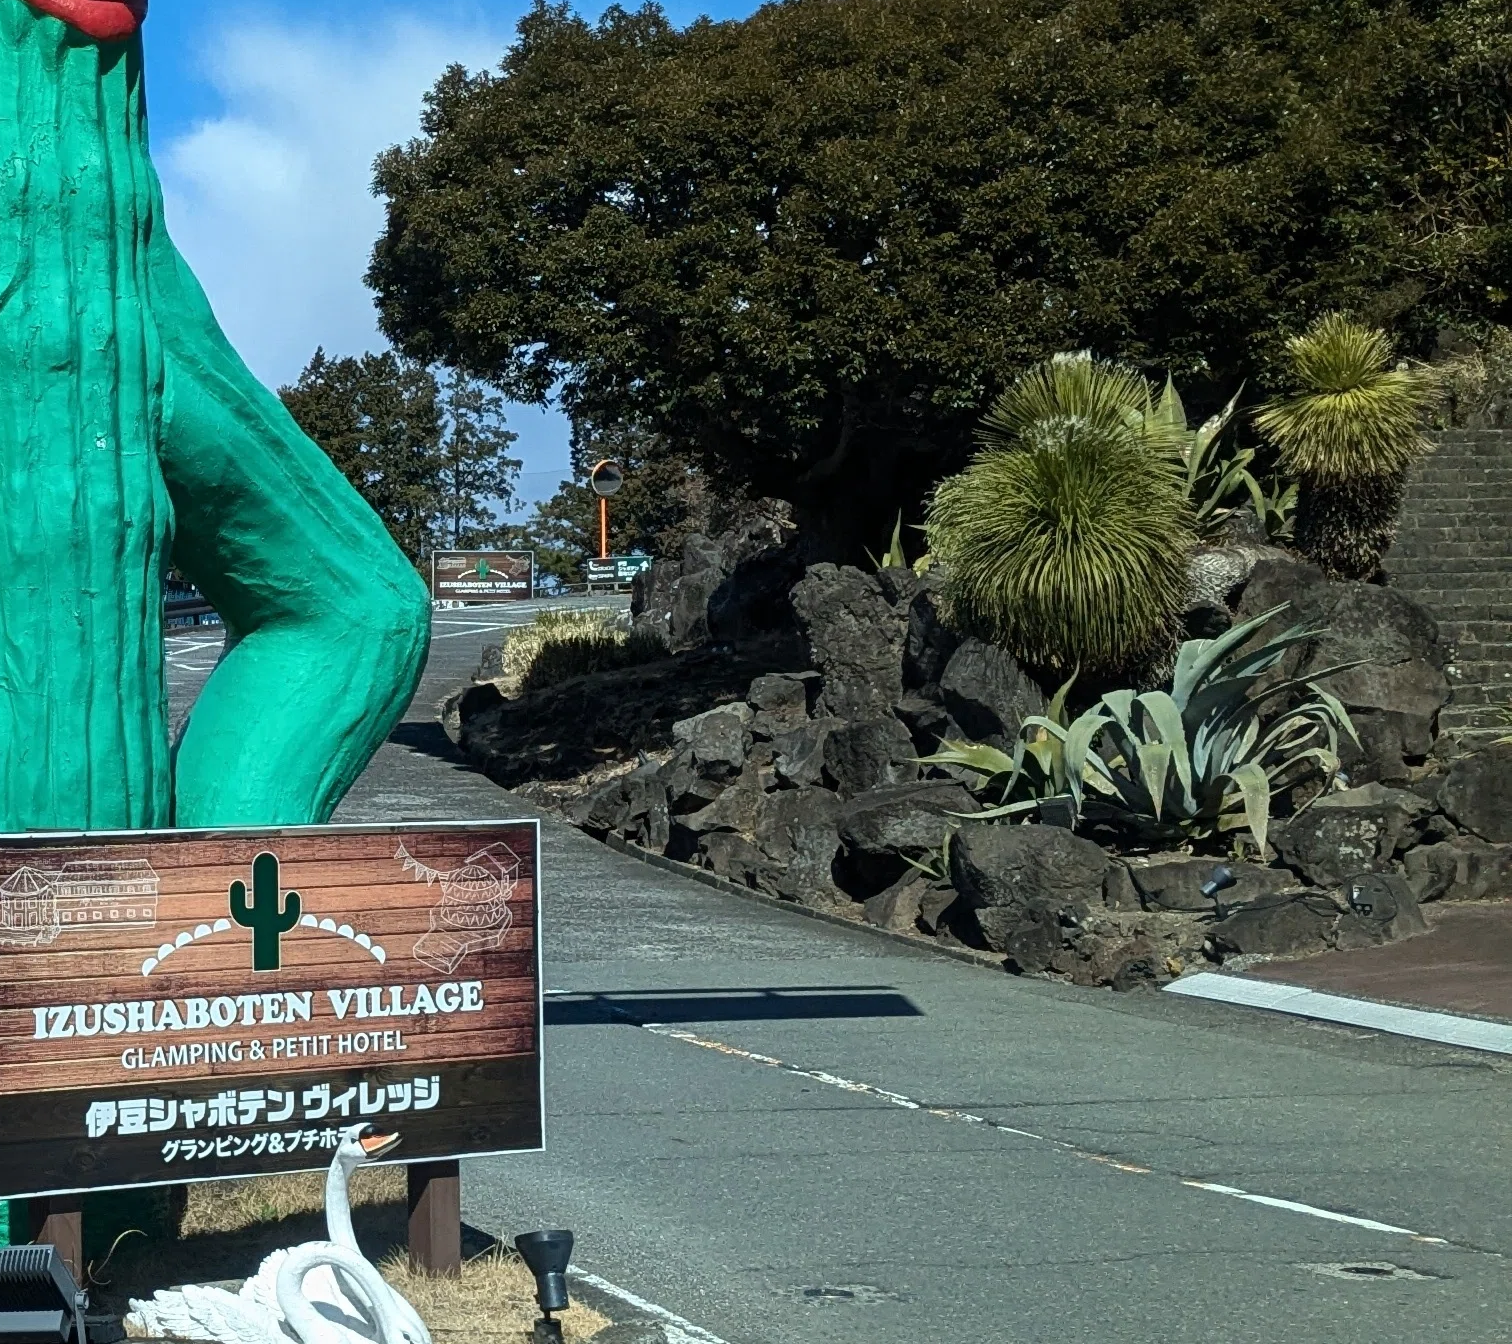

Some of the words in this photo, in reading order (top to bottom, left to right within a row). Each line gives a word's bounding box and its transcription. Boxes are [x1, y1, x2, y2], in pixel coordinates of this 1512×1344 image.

[32, 992, 314, 1040] IZUSHABOTEN
[327, 980, 485, 1020] VILLAGE
[121, 1040, 243, 1070] GLAMPING
[249, 1039, 266, 1060] &
[273, 1034, 332, 1059] PETIT
[338, 1030, 408, 1054] HOTEL
